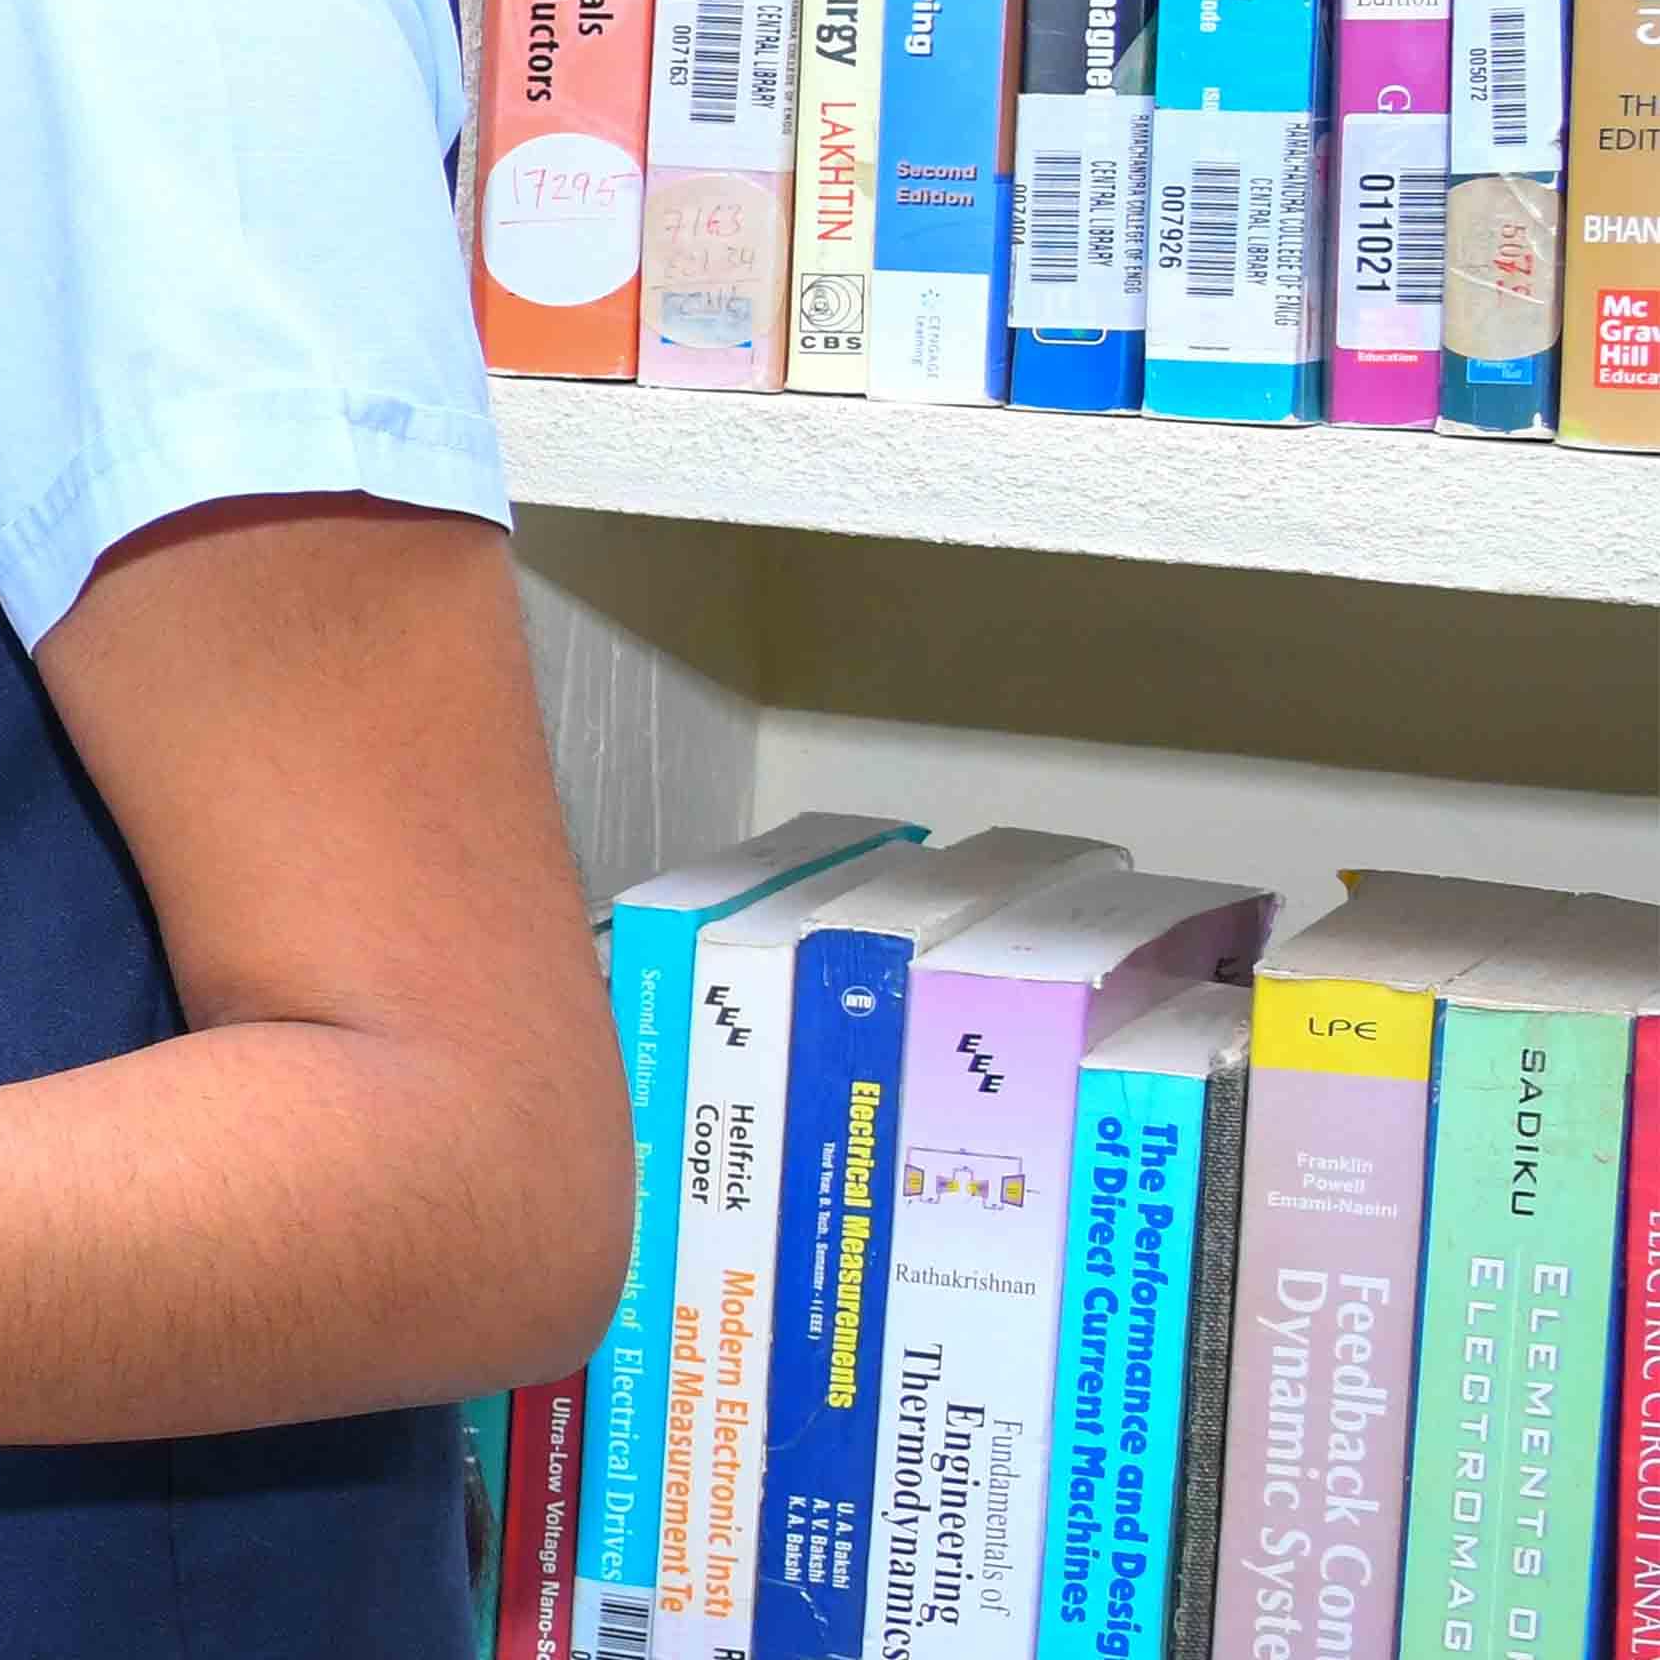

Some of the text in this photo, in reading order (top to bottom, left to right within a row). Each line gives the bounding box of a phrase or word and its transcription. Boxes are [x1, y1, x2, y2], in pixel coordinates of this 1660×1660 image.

[669, 24, 692, 86] 007163
[1470, 47, 1489, 103] 005072
[817, 101, 856, 240] LAKHTIN
[897, 161, 976, 182] Second
[897, 187, 973, 208] Edition
[1159, 186, 1186, 269] 007926
[1357, 173, 1395, 294] 011021
[690, 1103, 720, 1205] Cooper
[724, 1103, 755, 1213] Helfrick
[1296, 1152, 1373, 1173] Franklin
[1511, 1048, 1546, 1218] SADIKU
[827, 1081, 881, 1409] Electrical Measurements
[895, 1262, 1038, 1295] Rathakrishnan
[663, 1306, 702, 1575] and Measurement
[710, 1268, 757, 1535] Modern Electronic
[1060, 1116, 1131, 1623] of Direct Current Machines
[1095, 1123, 1178, 1660] The Performance and Desig
[1325, 1272, 1391, 1524] Feedback
[1511, 1264, 1570, 1578] ELEMENTS
[541, 1397, 572, 1573] Ultra-Low Voltage
[602, 1345, 644, 1581] Electrical Drives
[881, 1343, 943, 1660] Thermodynamics
[920, 1401, 985, 1626] Engineering
[980, 1420, 1023, 1617] Fundamentals of
